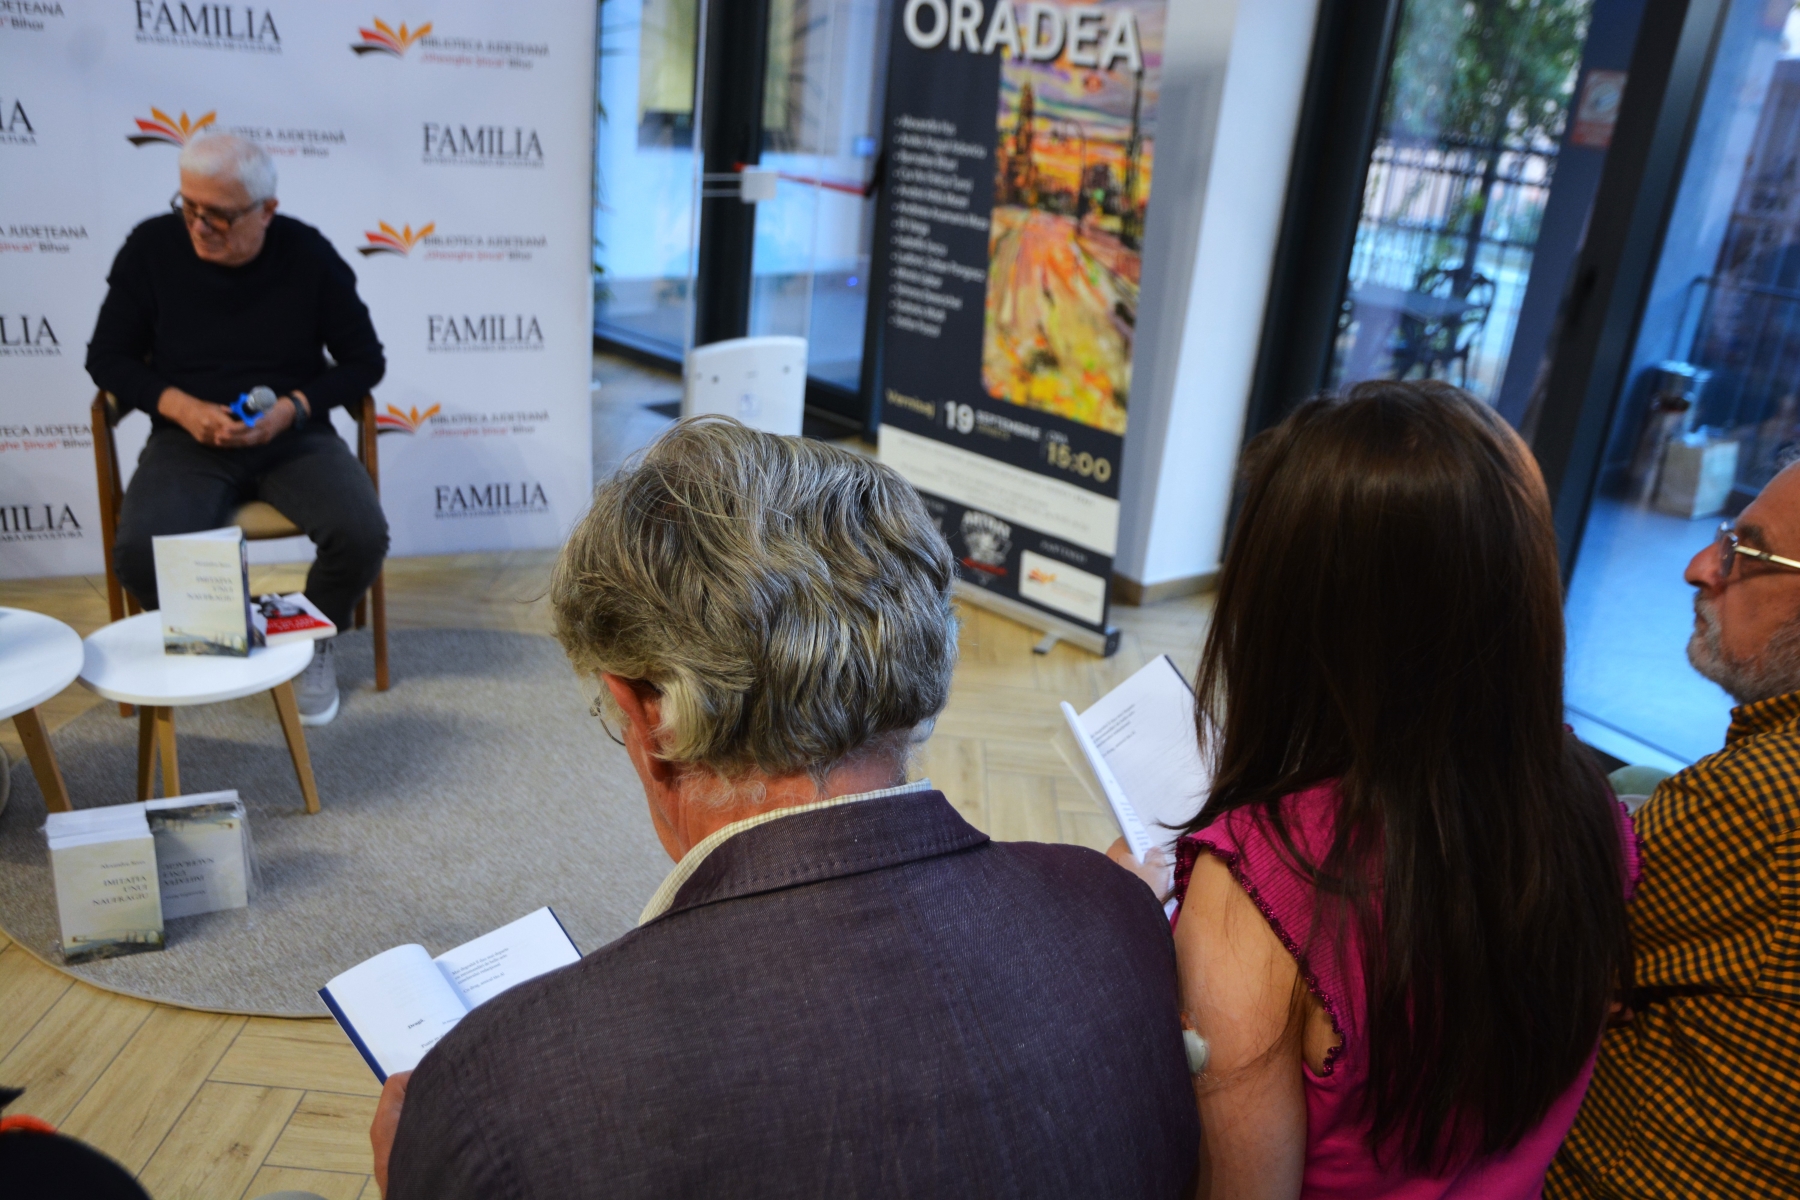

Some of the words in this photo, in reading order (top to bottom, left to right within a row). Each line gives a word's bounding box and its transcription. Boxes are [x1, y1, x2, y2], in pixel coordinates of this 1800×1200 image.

[135, 0, 282, 44] FAMILIA
[903, 0, 1141, 71] ORADEA
[423, 123, 544, 157] FAMILIA
[428, 315, 544, 342] FAMILIA
[944, 400, 974, 435] 19
[975, 409, 1042, 441] SEPTEMBRIE
[1047, 441, 1111, 484] 15:00
[435, 482, 548, 510] FAMILIA
